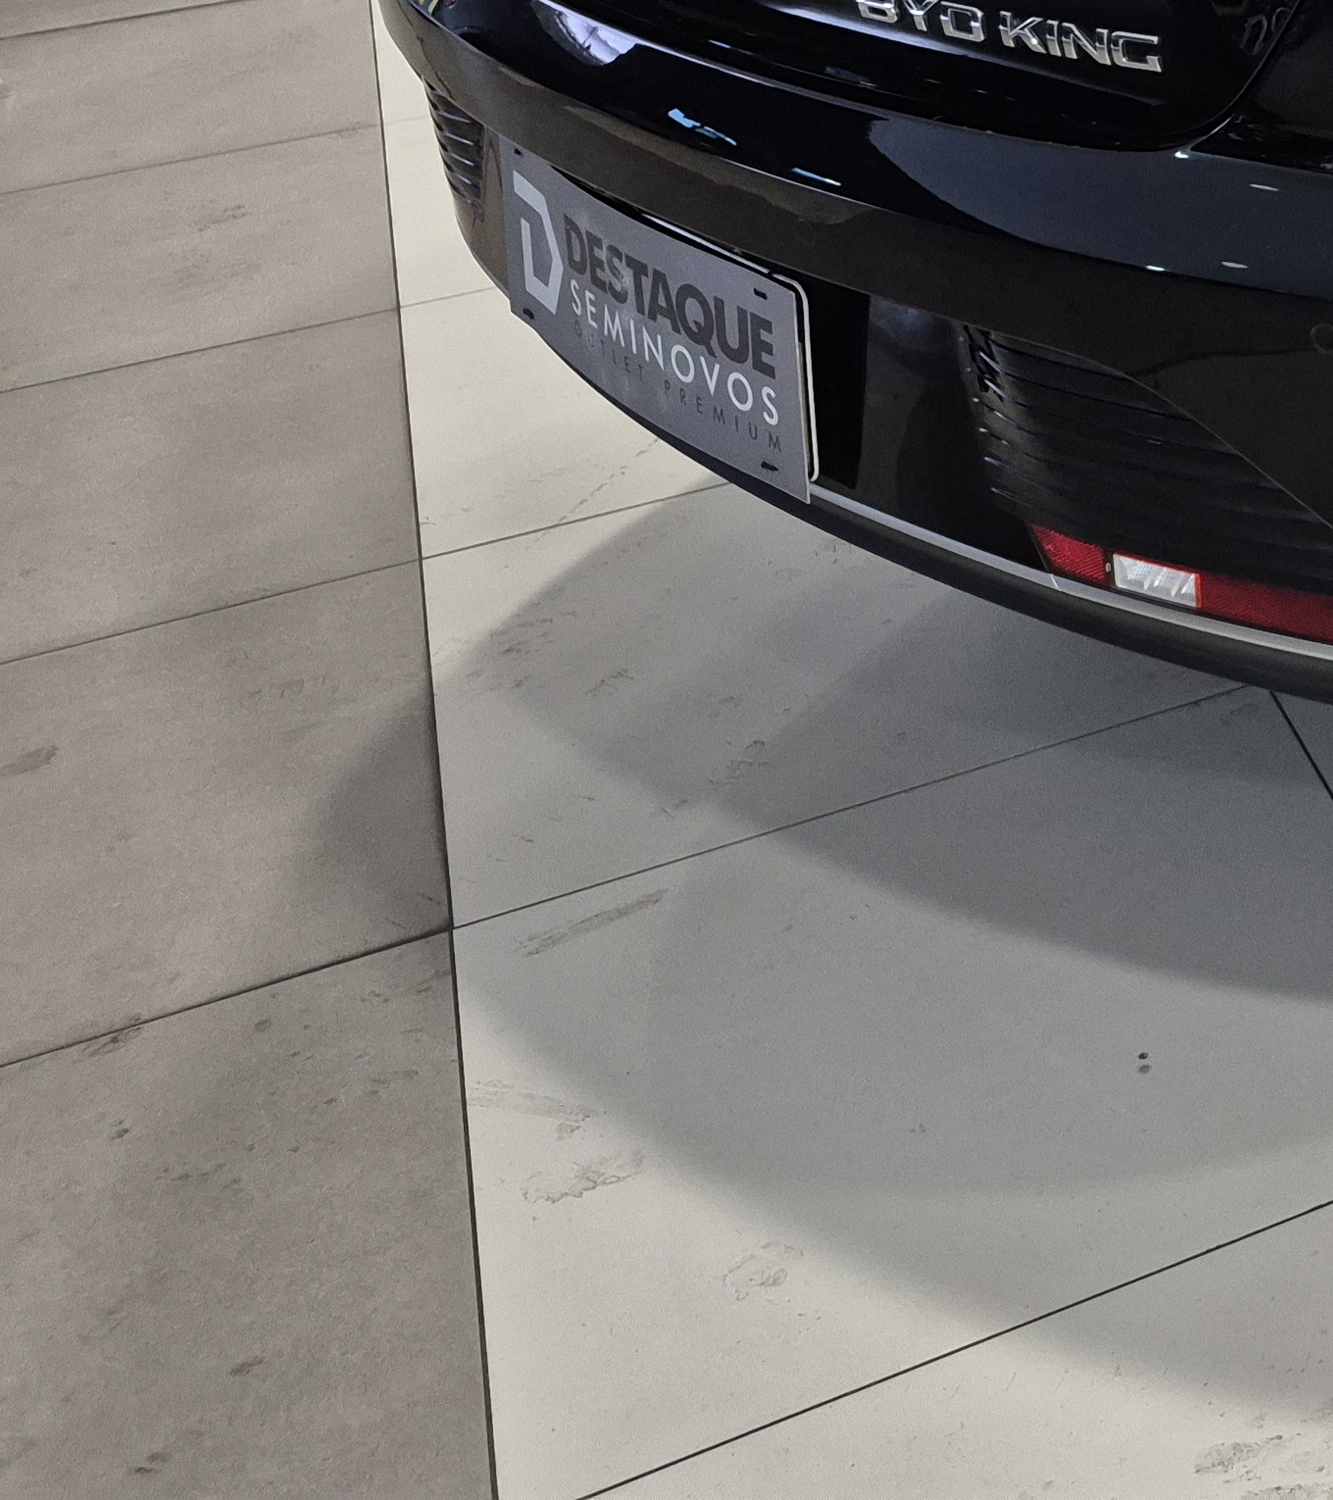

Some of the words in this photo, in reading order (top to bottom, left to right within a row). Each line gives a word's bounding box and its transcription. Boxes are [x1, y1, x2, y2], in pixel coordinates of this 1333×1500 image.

[999, 10, 1162, 73] KING
[563, 212, 776, 380] DESTAQUE
[570, 278, 779, 426] SEMINOVOS
[664, 379, 782, 453] PREMIUM
